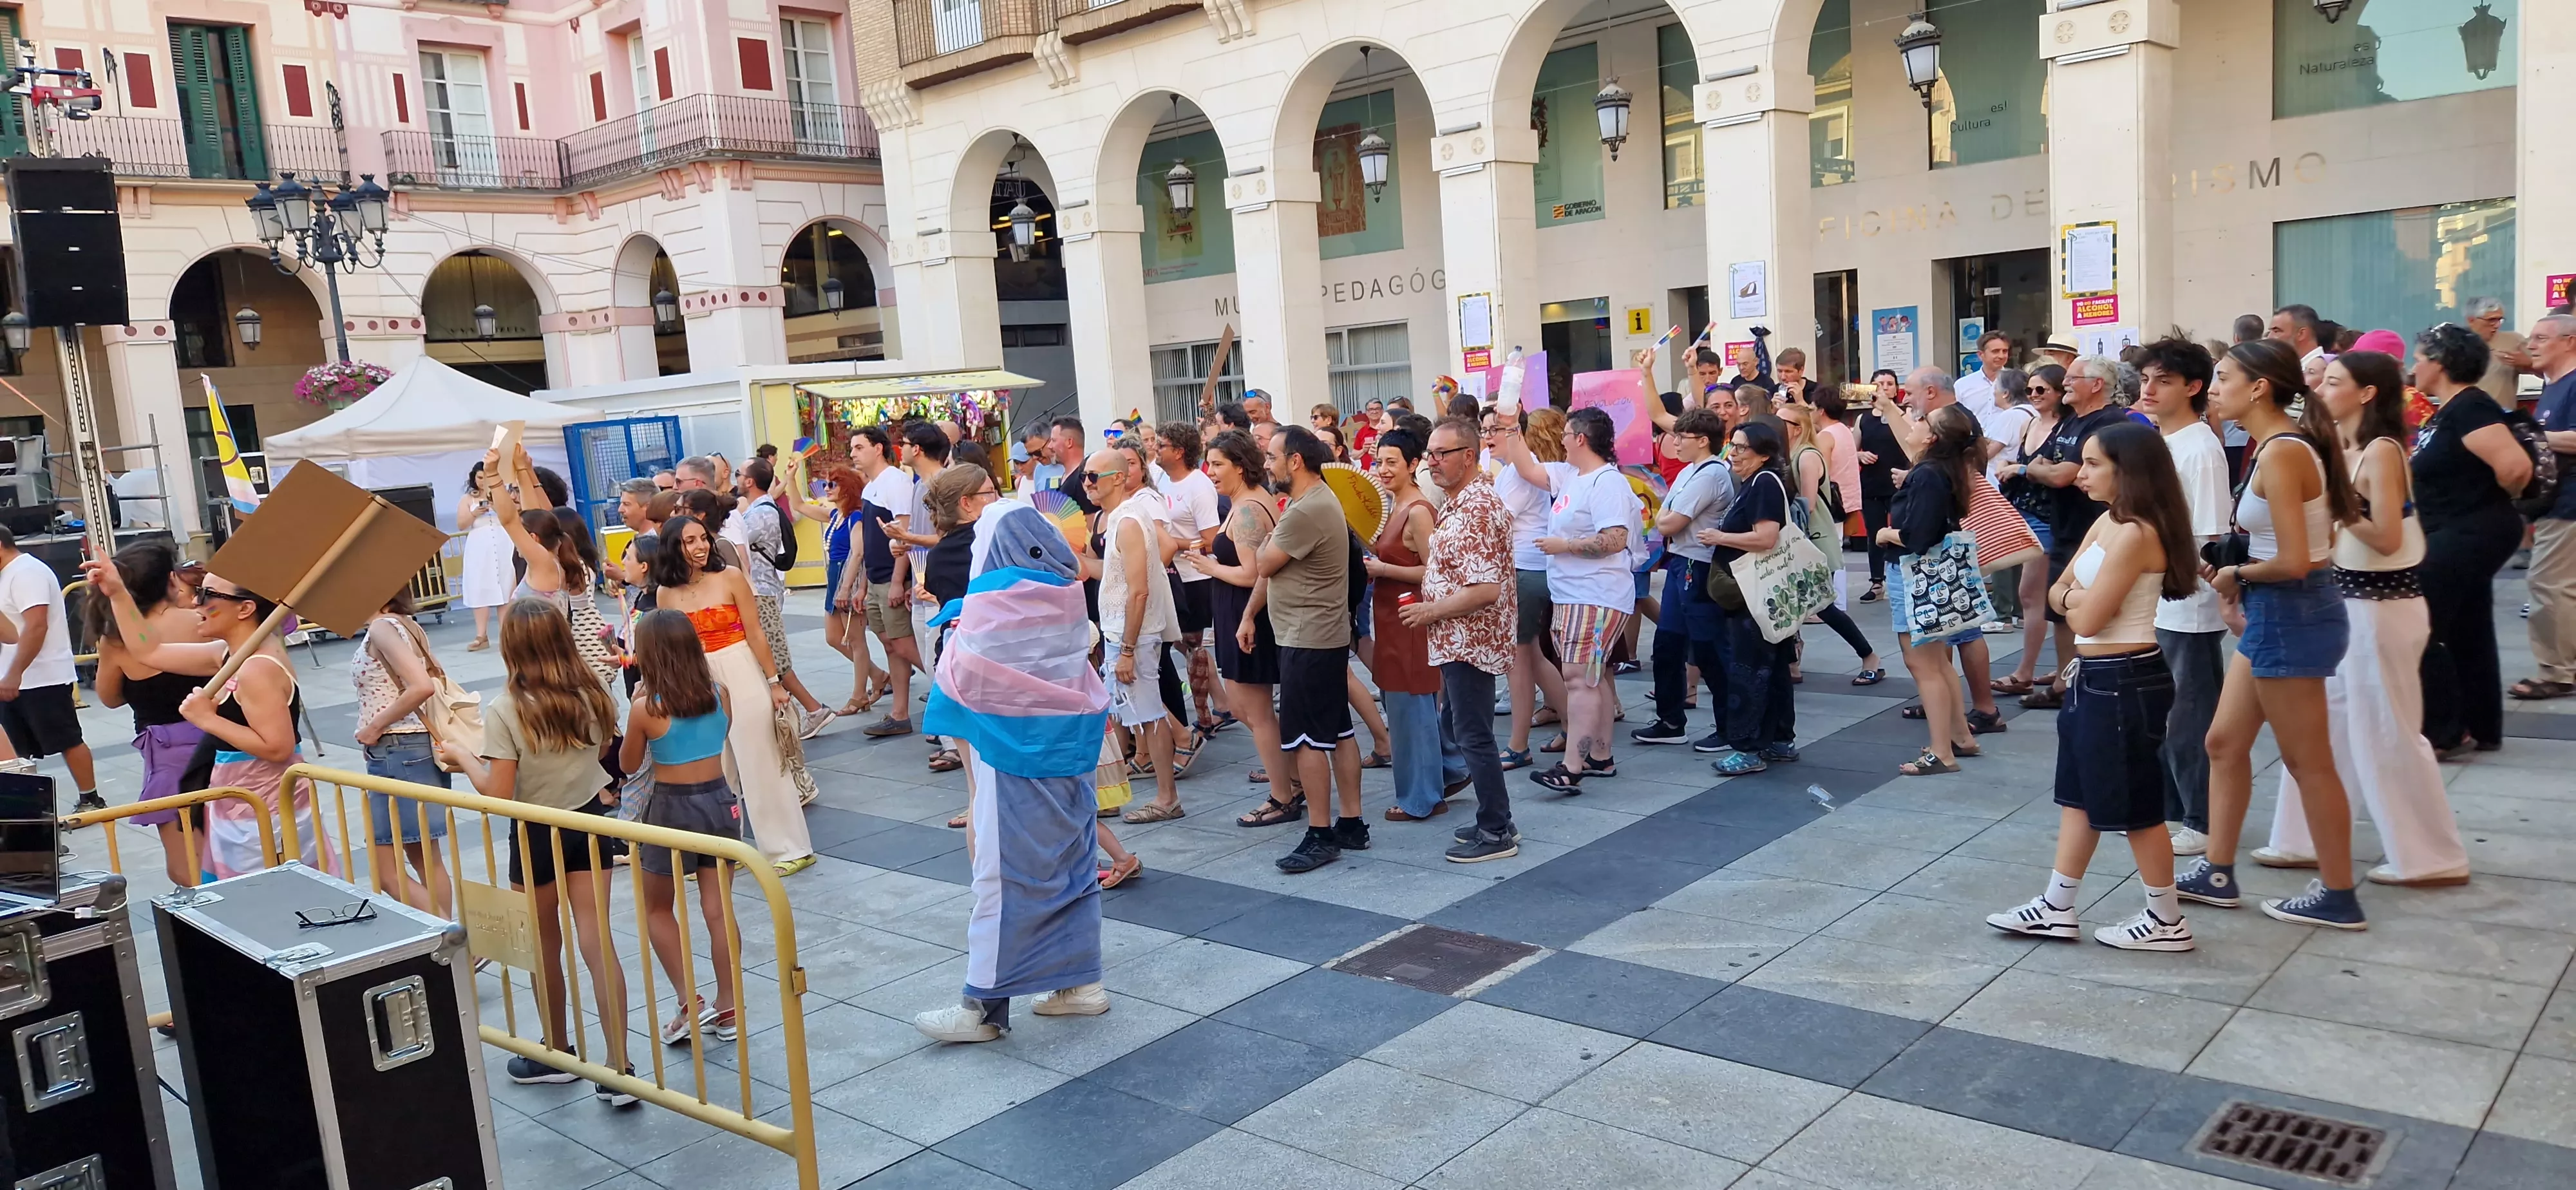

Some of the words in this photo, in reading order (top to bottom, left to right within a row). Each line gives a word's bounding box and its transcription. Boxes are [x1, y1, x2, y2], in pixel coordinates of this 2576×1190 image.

[1950, 118, 1991, 133] Cultura
[1564, 199, 1597, 210] GOBIERNO
[1991, 188, 2045, 222] DE
[2077, 303, 2114, 314] ALCOHOL
